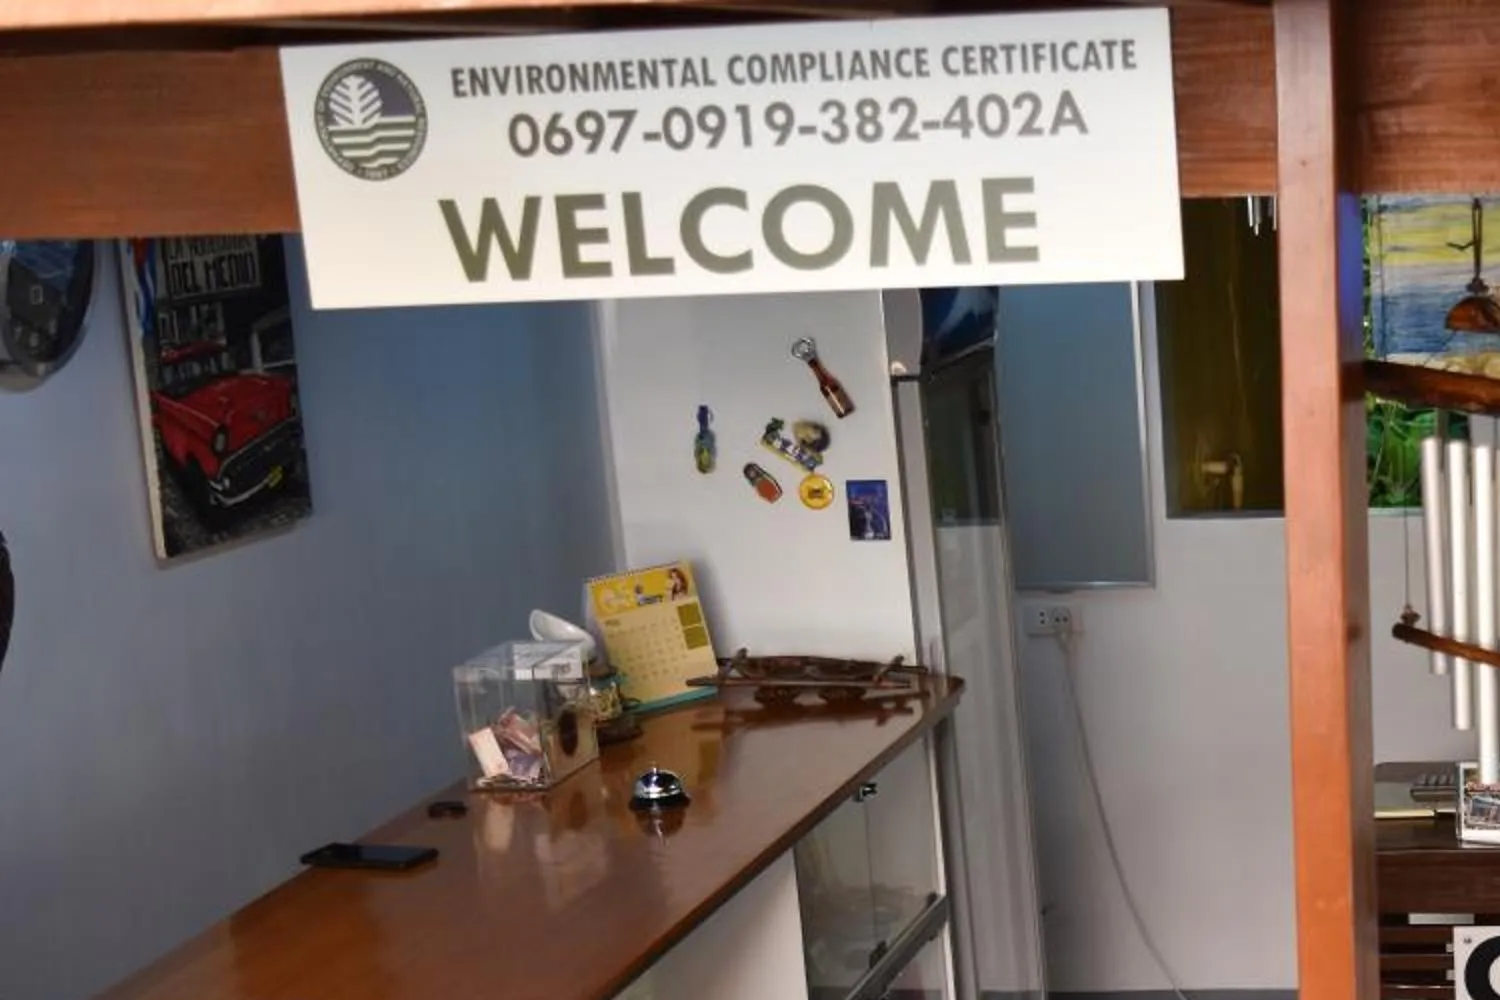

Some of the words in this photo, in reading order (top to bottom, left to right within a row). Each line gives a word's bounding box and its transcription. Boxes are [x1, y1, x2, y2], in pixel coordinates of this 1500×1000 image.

[451, 57, 716, 98] ENVIRONMENTAL
[727, 48, 930, 87] COMPLIANCE
[942, 39, 1137, 77] CERTIFICATE
[508, 89, 1089, 158] 0697-0919-382-402A
[437, 176, 1040, 283] WELCOME
